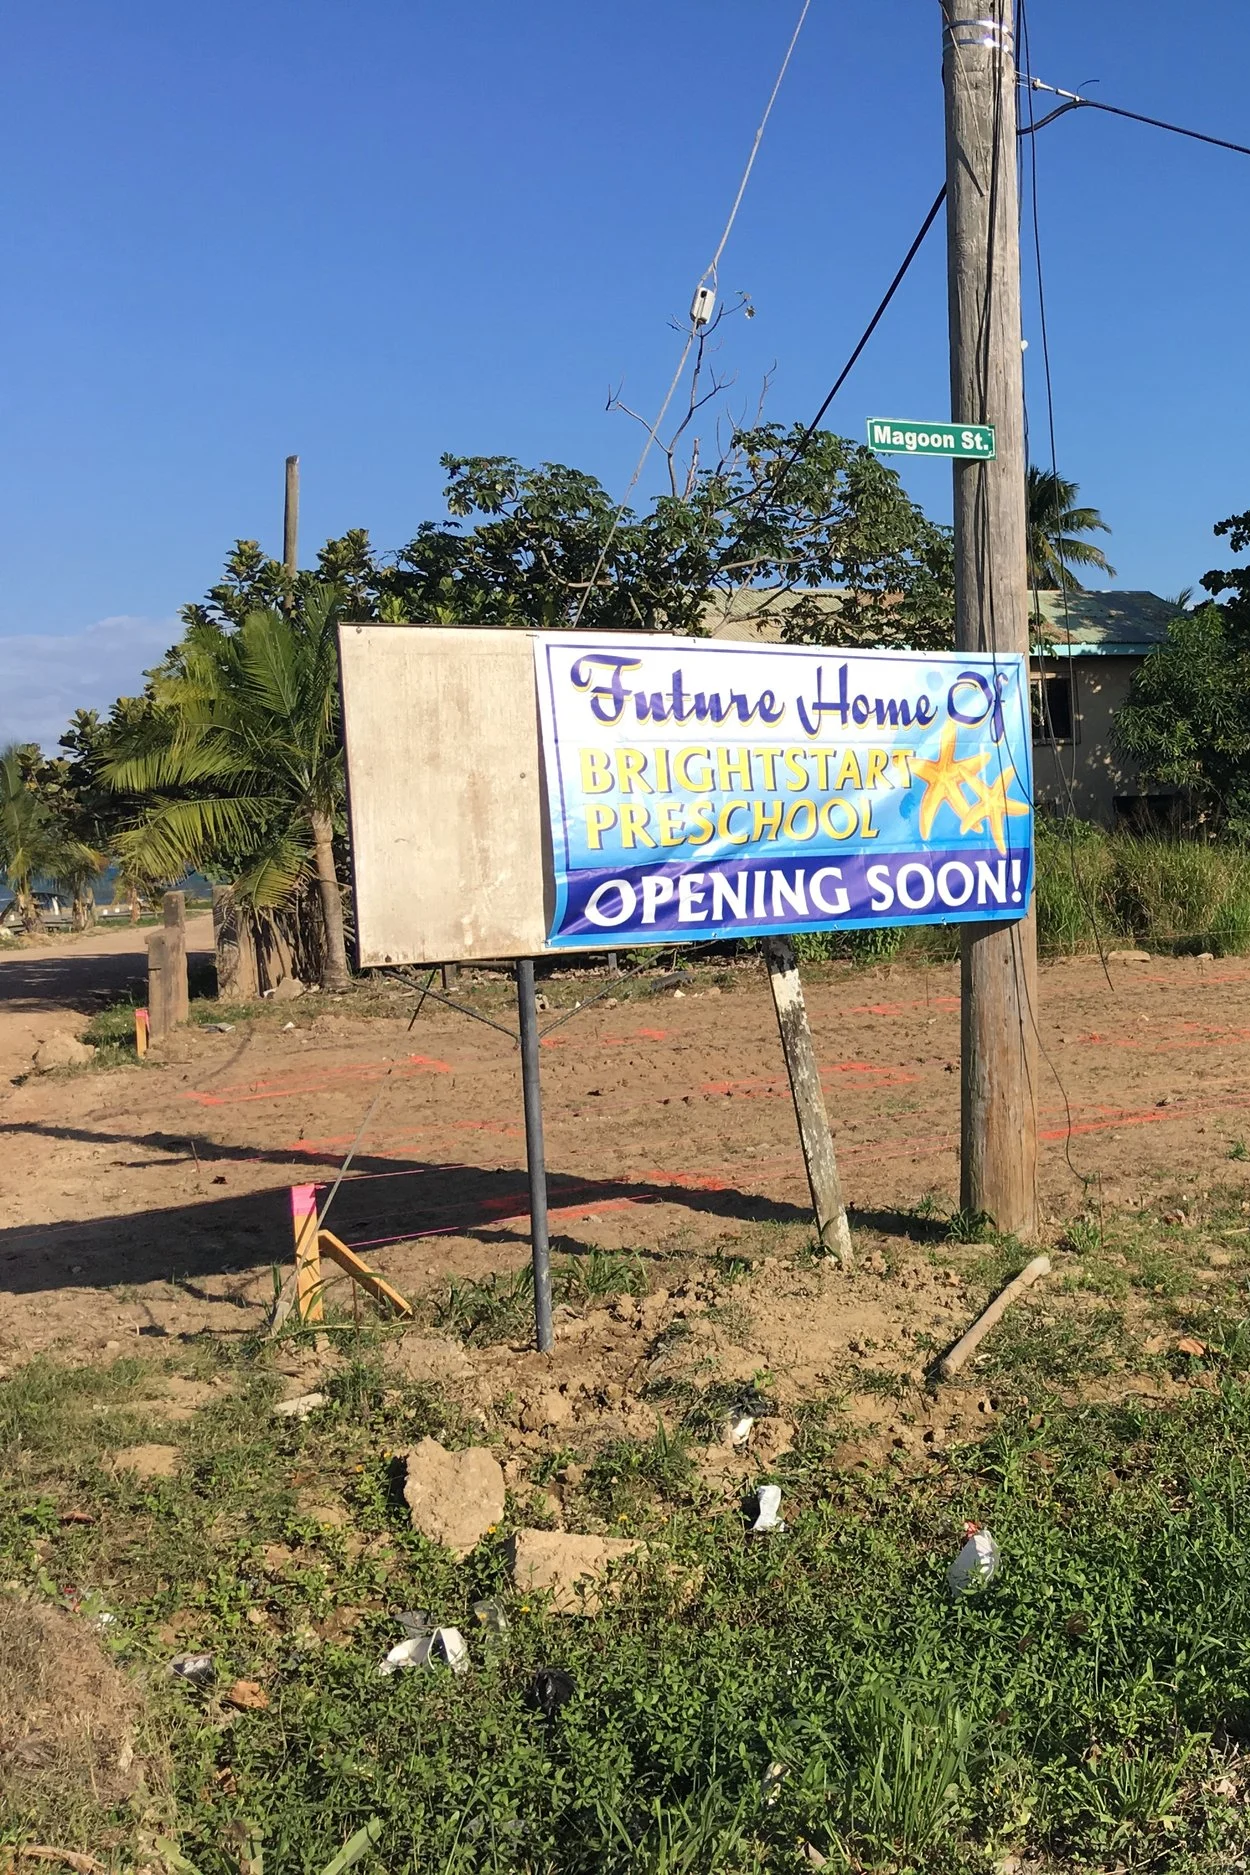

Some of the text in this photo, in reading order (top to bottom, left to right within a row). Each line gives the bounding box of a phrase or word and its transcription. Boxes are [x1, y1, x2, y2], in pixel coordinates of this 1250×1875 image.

[873, 425, 989, 450] Magoon St.
[570, 654, 1009, 746] Future Home Of
[579, 746, 916, 794] BRIGHTSTART
[584, 798, 880, 850] PRESCHOOL
[584, 859, 1022, 927] OPENING SOON!
